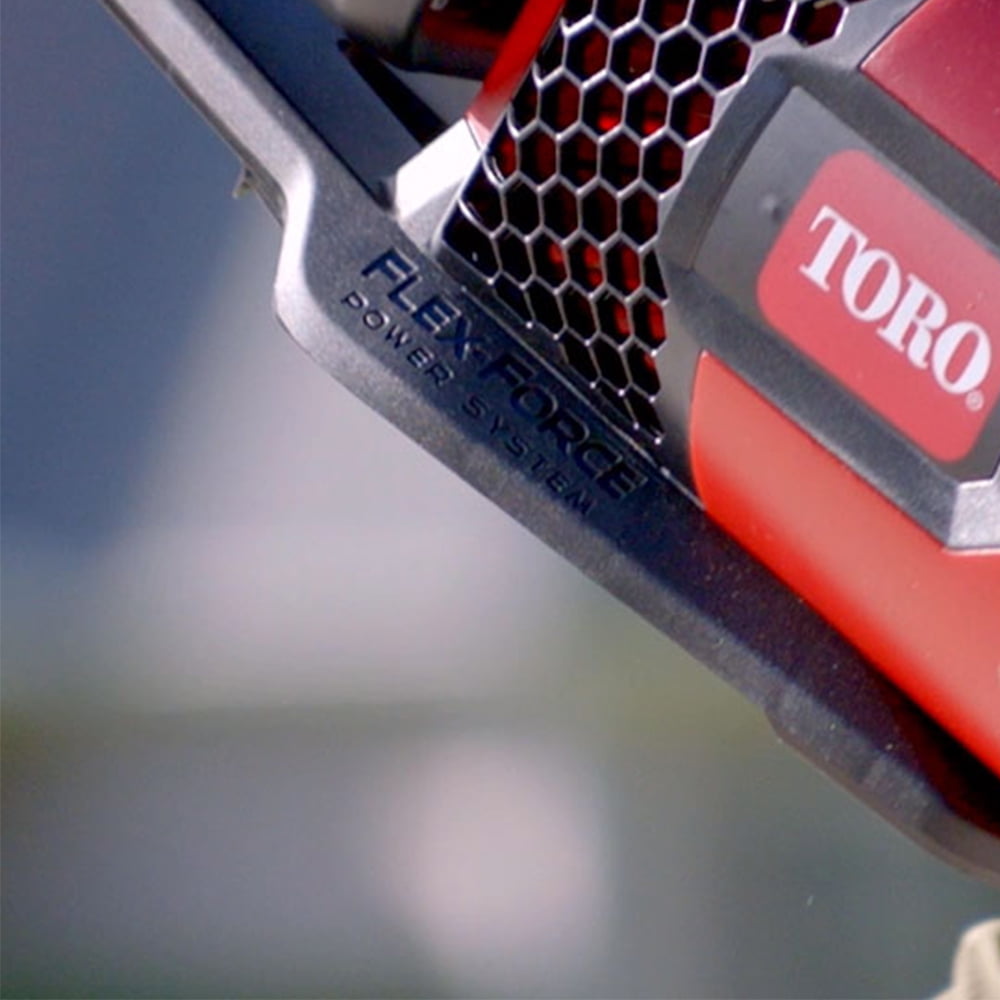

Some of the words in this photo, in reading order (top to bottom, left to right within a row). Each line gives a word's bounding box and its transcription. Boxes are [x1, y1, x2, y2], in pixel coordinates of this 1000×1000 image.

[341, 290, 454, 387] POWER
[461, 394, 598, 516] SYSTEM
[798, 205, 992, 395] TORO
